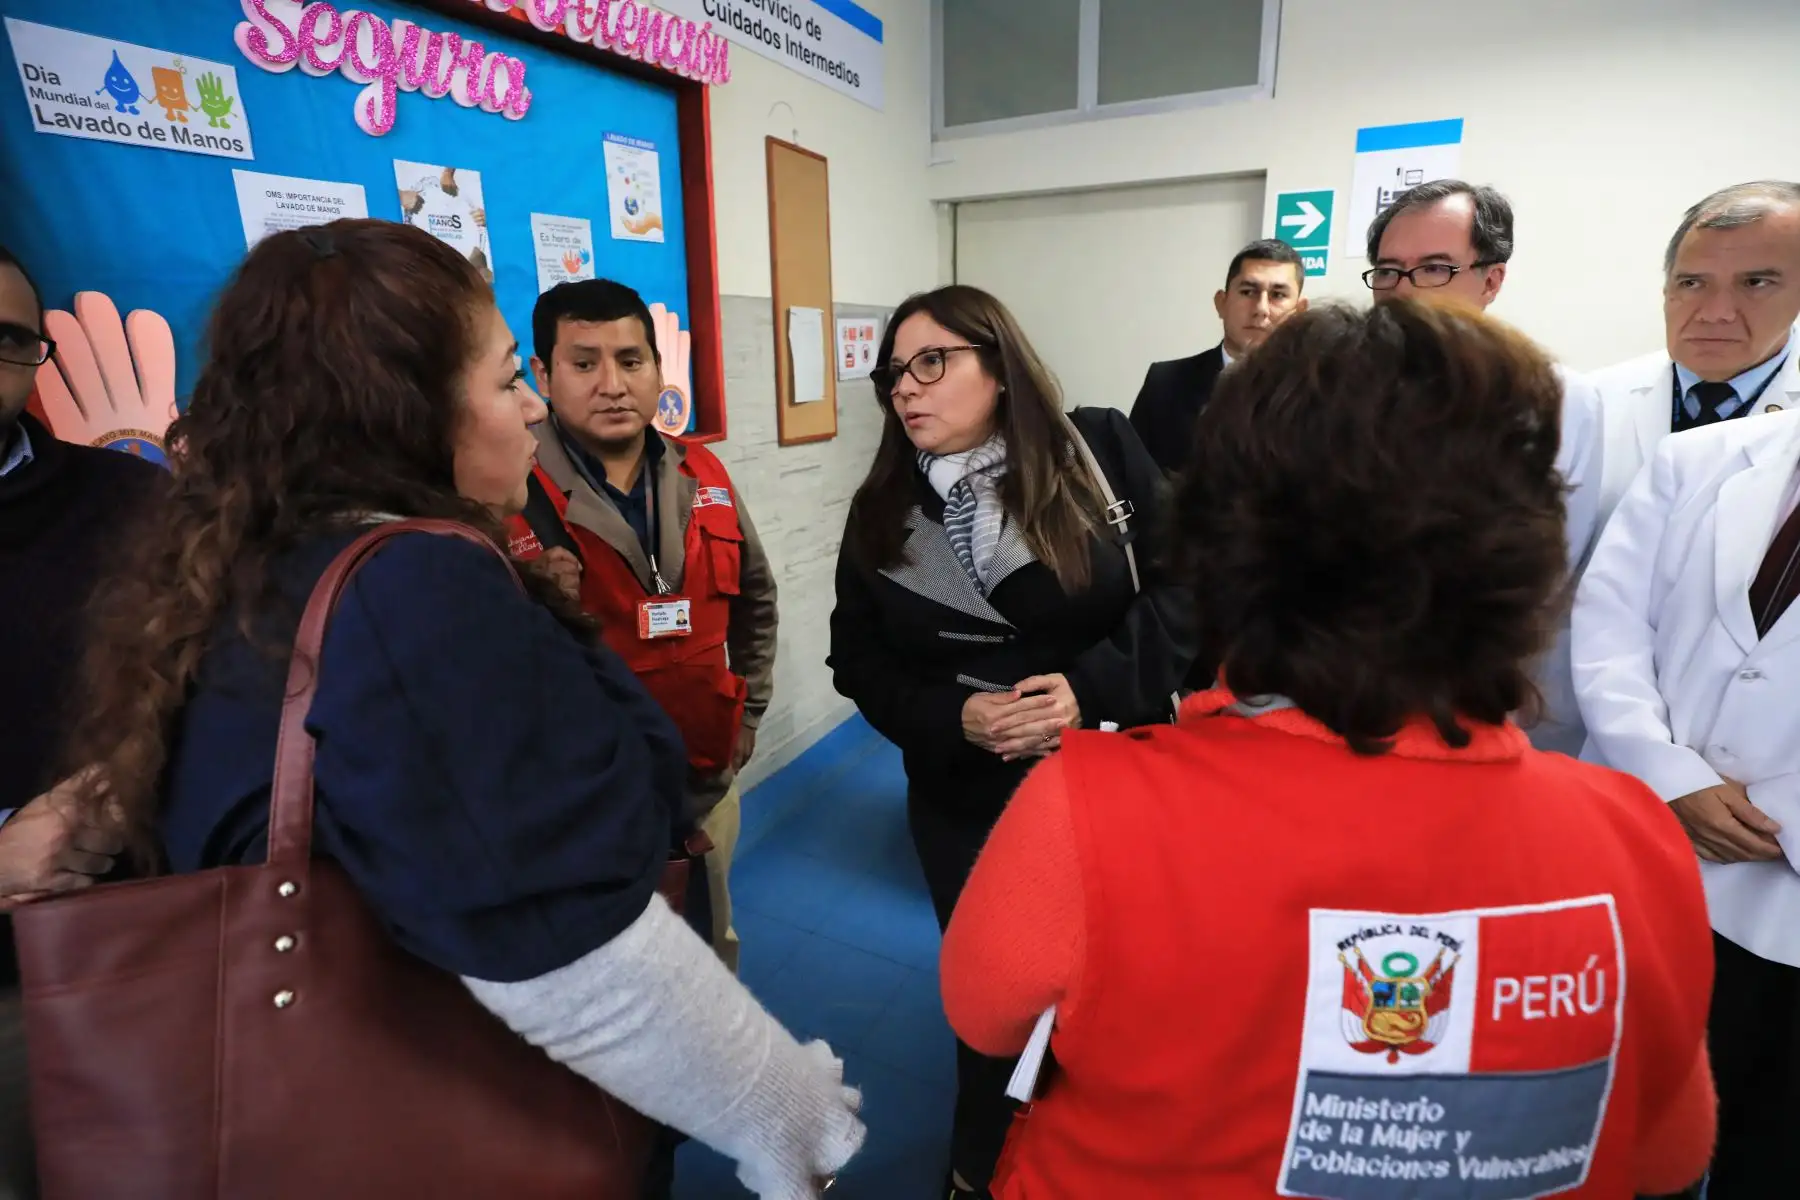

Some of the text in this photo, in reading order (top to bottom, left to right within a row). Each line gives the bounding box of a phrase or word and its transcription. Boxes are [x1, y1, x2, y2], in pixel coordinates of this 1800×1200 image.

[744, 0, 822, 42] ervicio de
[703, 0, 860, 88] Cuidados Intermedios
[22, 63, 61, 86] Dia
[234, 0, 532, 136] Segura
[29, 86, 110, 111] Mundial del
[34, 104, 244, 152] Lavado de Manos
[276, 201, 341, 214] LAVADO DE MANOS
[285, 192, 332, 203] IMPORTANCIA
[333, 197, 346, 206] DEL
[1409, 925, 1430, 939] DEL
[1492, 954, 1606, 1022] PERÚ
[1304, 1091, 1445, 1123] Ministerio
[1299, 1119, 1473, 1154] de la Mujer y
[1291, 1146, 1450, 1180] Poblaciones
